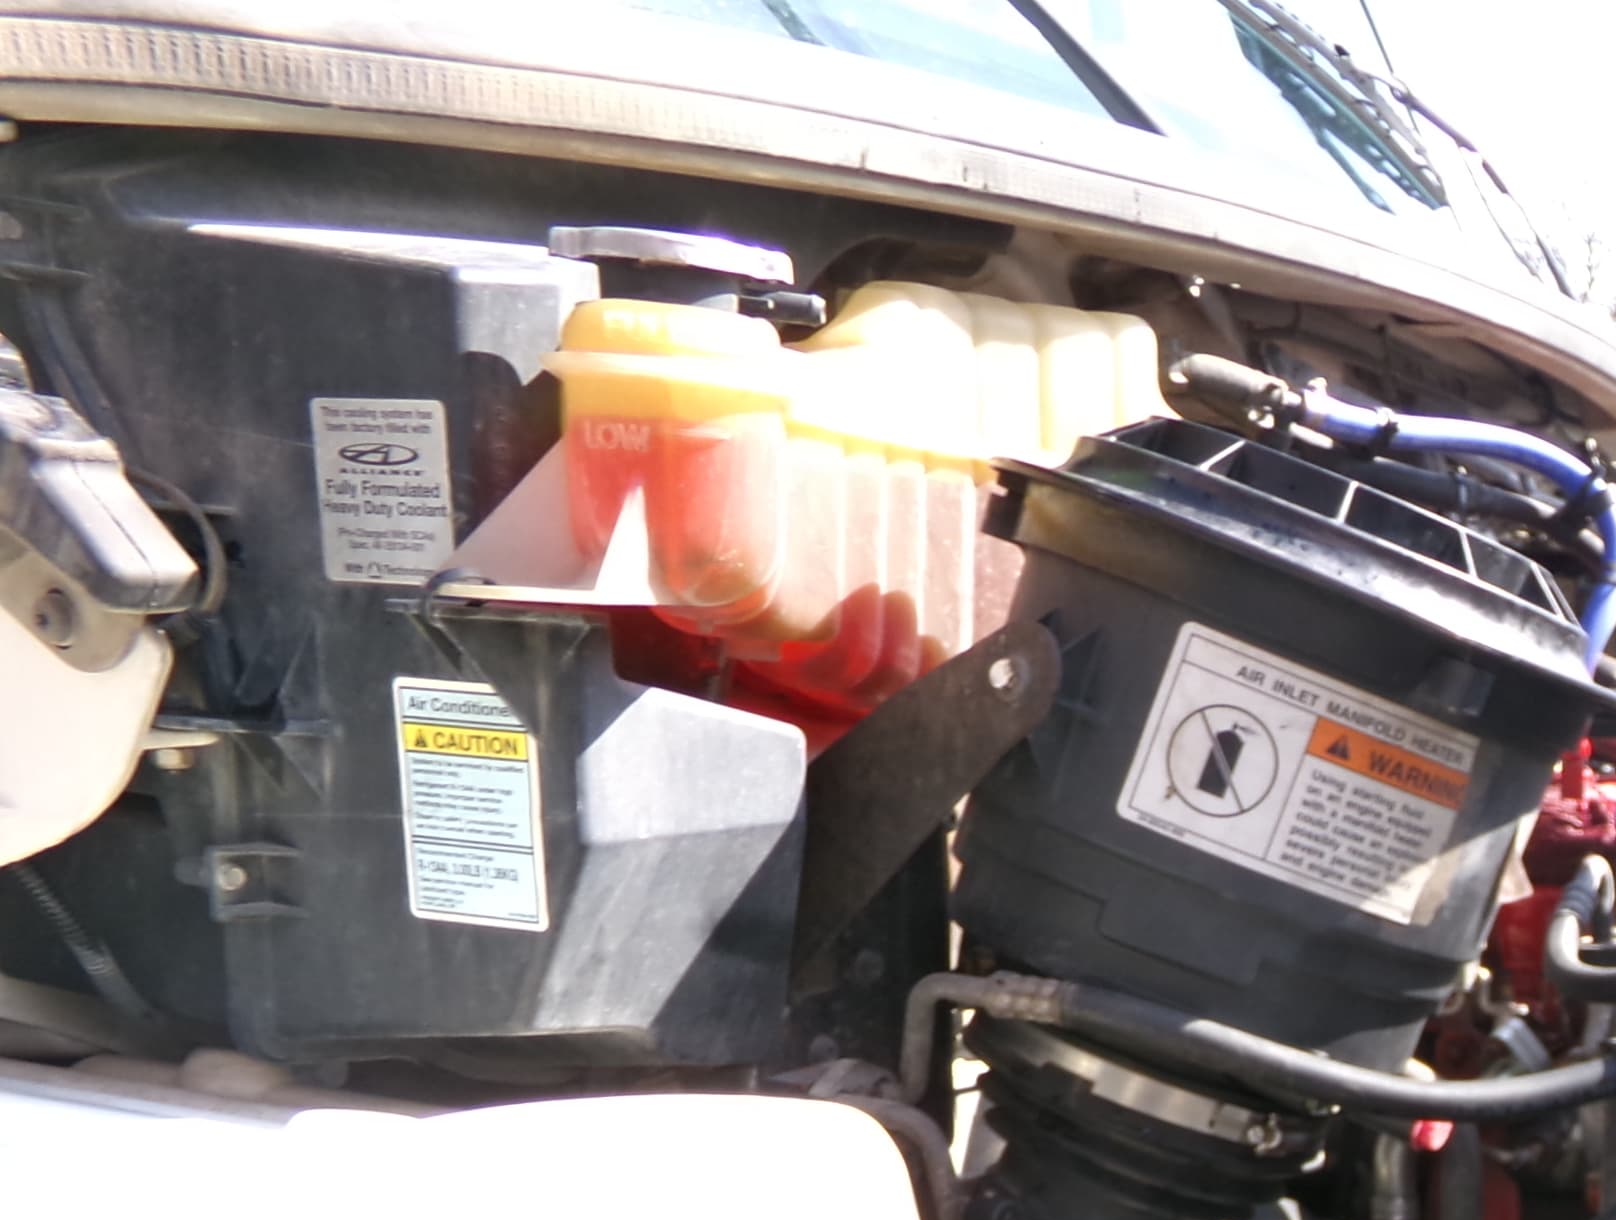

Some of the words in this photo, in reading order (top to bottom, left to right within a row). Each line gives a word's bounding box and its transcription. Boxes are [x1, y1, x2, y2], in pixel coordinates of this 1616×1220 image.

[584, 418, 651, 453] LOW
[339, 468, 424, 477] ALLIANCE
[325, 478, 357, 499] Fully
[360, 480, 441, 499] Formulated
[325, 500, 360, 518] Heavy
[363, 499, 393, 518] Duty
[397, 501, 447, 518] Coolant
[408, 695, 428, 711] Air
[430, 697, 512, 718] Conditione
[1237, 665, 1266, 687] AIR
[1271, 680, 1321, 708] INLET
[1325, 700, 1408, 743] MANIFOLD
[1411, 734, 1465, 765] HEATER
[433, 731, 519, 756] CAUTION
[1312, 769, 1348, 793] Using
[1352, 787, 1396, 812] starting
[1402, 803, 1426, 819] fluid
[1296, 811, 1329, 830] could
[1332, 825, 1366, 843] cause
[1302, 798, 1327, 813] with
[1342, 813, 1390, 837] manifold
[1327, 792, 1342, 802] an
[1345, 800, 1383, 819] engine
[1387, 815, 1434, 838] equipped
[1289, 825, 1341, 852] possibly
[1280, 852, 1304, 867] and
[1308, 862, 1346, 882] engine
[1286, 838, 1325, 859] severe
[1330, 855, 1380, 879] personal
